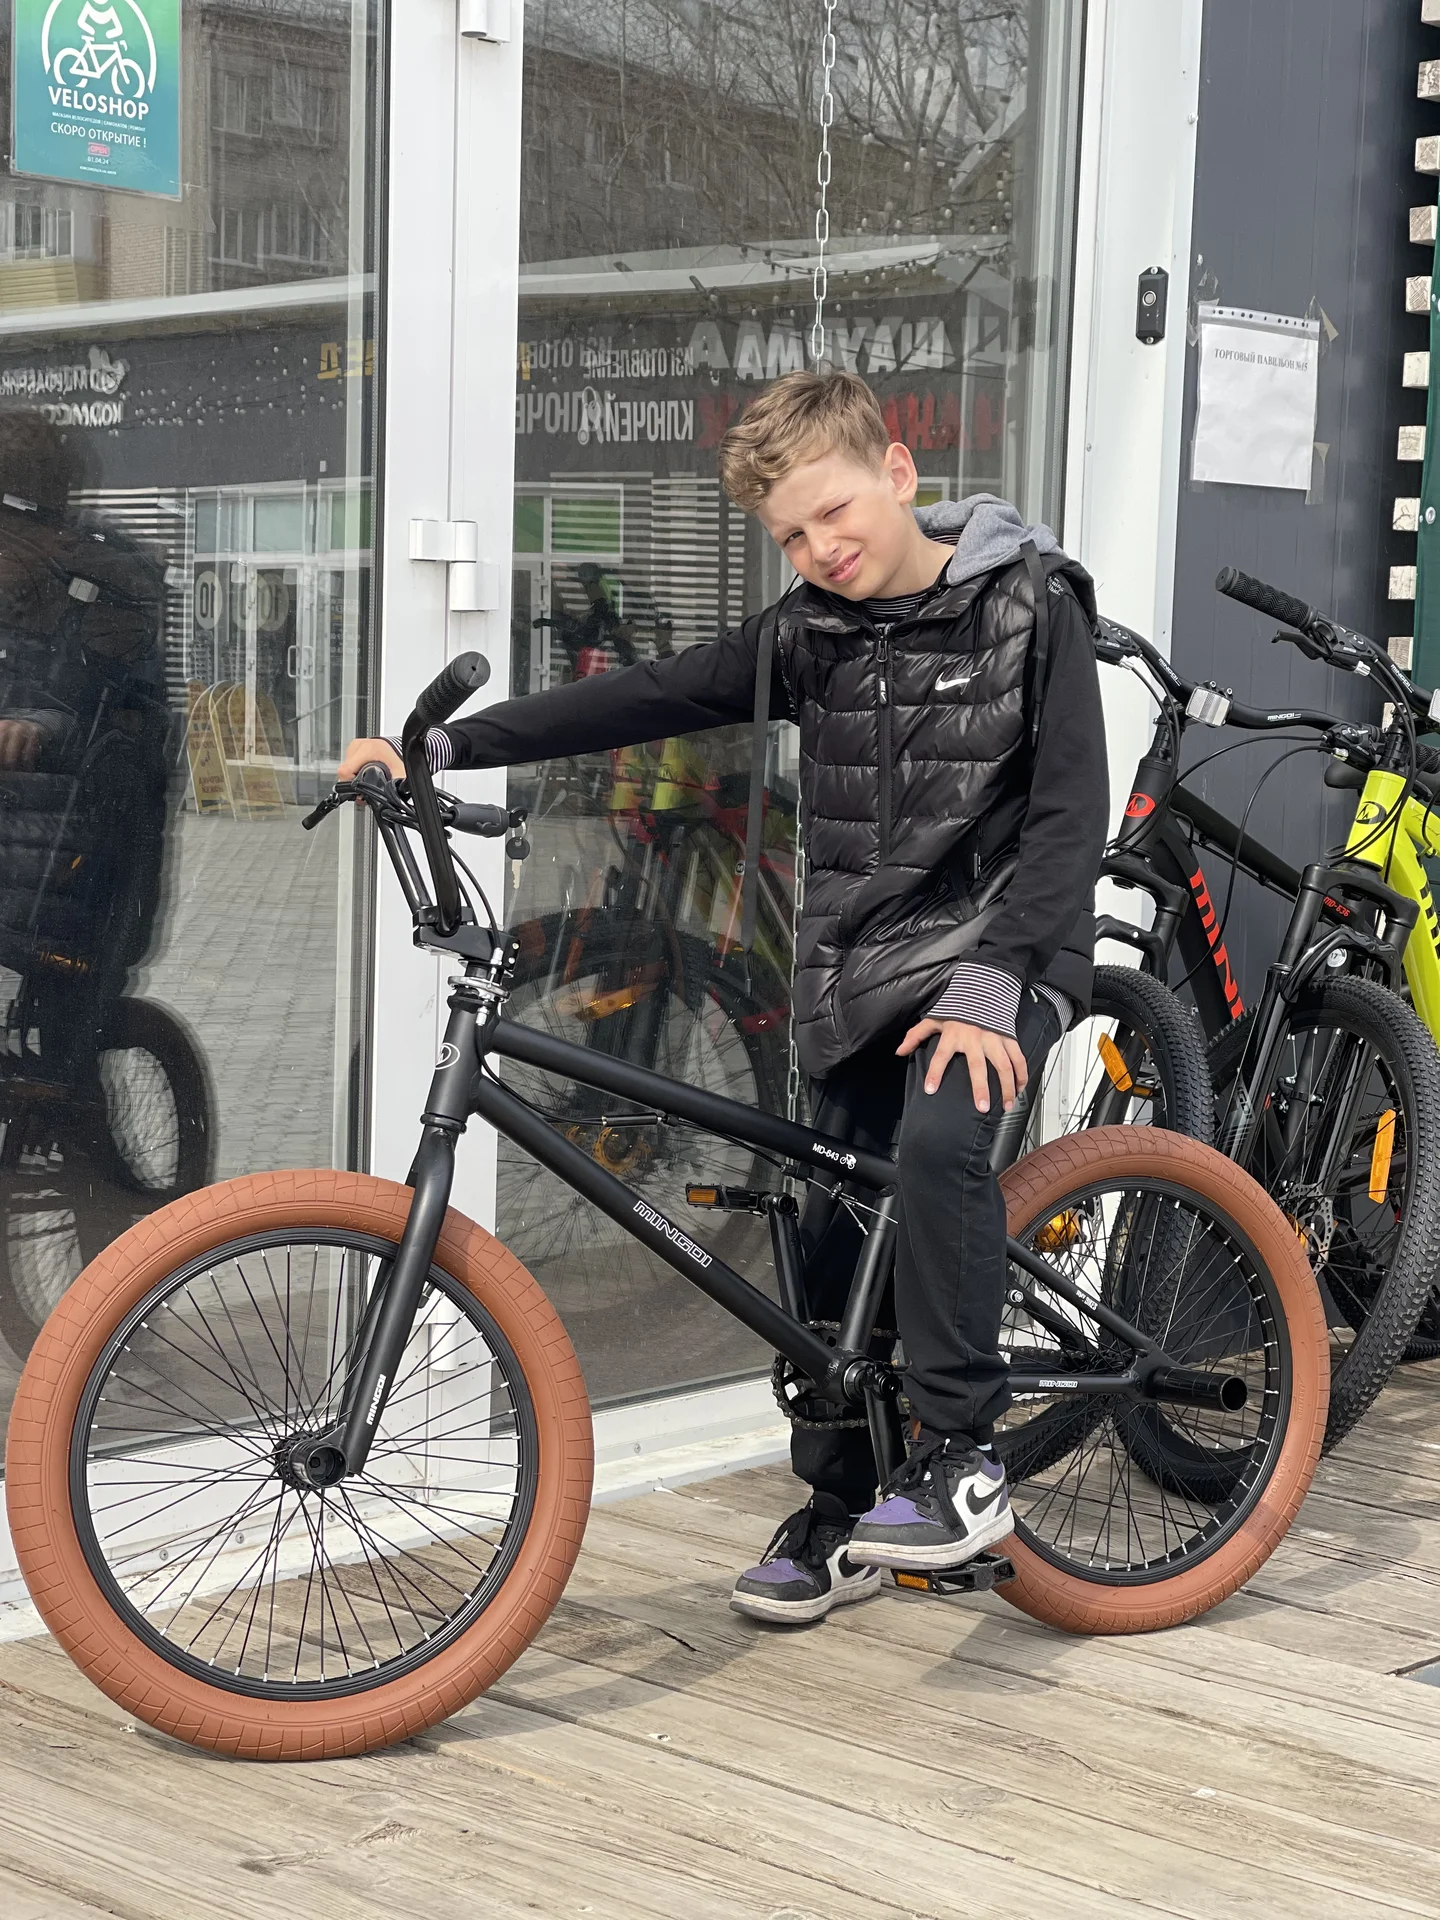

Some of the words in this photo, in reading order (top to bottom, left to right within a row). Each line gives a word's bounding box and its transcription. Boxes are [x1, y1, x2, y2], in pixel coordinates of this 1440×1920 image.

[48, 85, 149, 120] VELOSHOP
[50, 121, 86, 138] СКОРО
[88, 128, 141, 147] ОТКРЫТИЕ
[87, 156, 109, 165] 01.04.24
[89, 144, 108, 154] OPEN
[1214, 348, 1256, 364] ТОРГОВЫЙ
[1257, 354, 1295, 369] ПАВИЛЬОН
[1295, 360, 1308, 372] №15
[812, 1142, 840, 1162] MD-643
[633, 1200, 714, 1269] MINGDI
[365, 1373, 387, 1426] MINGDI
